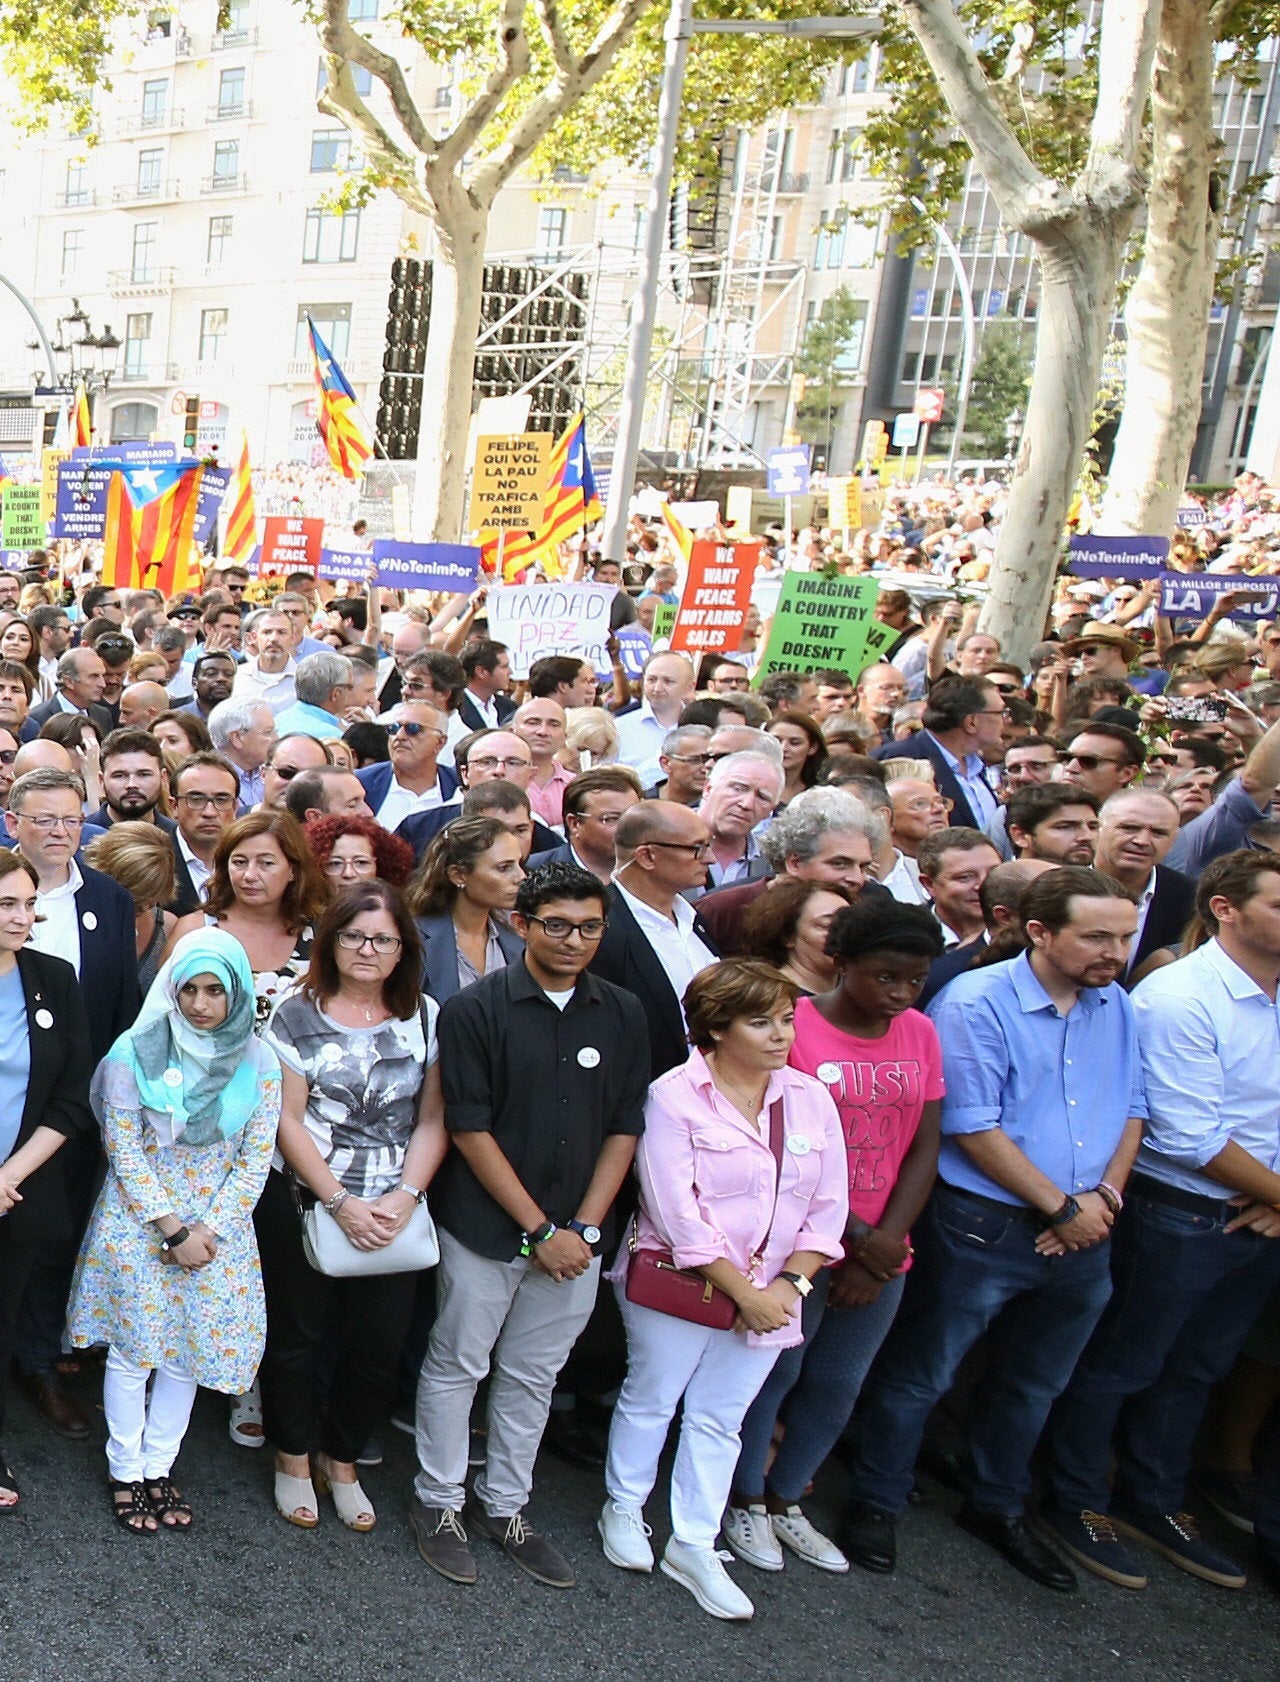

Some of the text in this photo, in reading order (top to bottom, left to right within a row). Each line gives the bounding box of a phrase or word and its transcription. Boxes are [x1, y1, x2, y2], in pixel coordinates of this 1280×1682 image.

[488, 441, 540, 452] FELIPE,
[126, 449, 174, 461] MARIANO
[483, 454, 541, 464] QUI VOL
[60, 470, 111, 481] MARANO
[485, 467, 538, 477] LA PAU
[66, 481, 104, 491] VOEM
[497, 480, 519, 489] NO
[477, 492, 540, 502] TRAFICA
[11, 502, 41, 512] COUNTR
[74, 503, 91, 512] NO
[491, 505, 523, 515] AMB
[15, 513, 34, 523] THAT
[61, 512, 106, 523] VENDRE
[481, 518, 530, 527] ARMES
[9, 525, 39, 535] DOESN'T
[63, 523, 102, 534] ARMES
[287, 519, 304, 533] WE
[4, 537, 43, 547] SELL ARMS
[277, 534, 308, 547] WANT
[271, 548, 308, 564] PEACE,
[332, 552, 364, 565] NO A
[715, 546, 736, 564] WE
[379, 557, 473, 578] #NoTenimPor
[703, 567, 740, 585] WANT
[796, 580, 863, 599] IMAGINE
[1165, 579, 1178, 588] LA
[1181, 581, 1222, 591] MILLOR
[694, 588, 736, 606] PEACE,
[1162, 588, 1202, 613] LA
[496, 587, 606, 621] UNIDAD
[781, 599, 869, 621] A COUNTRY
[679, 609, 706, 626] NOT
[704, 609, 744, 626] ARMS
[519, 619, 579, 653] PAZ
[800, 622, 840, 639] THAT
[686, 629, 727, 647] SALES
[781, 641, 847, 662] DOESN'T
[840, 1104, 904, 1150] DO
